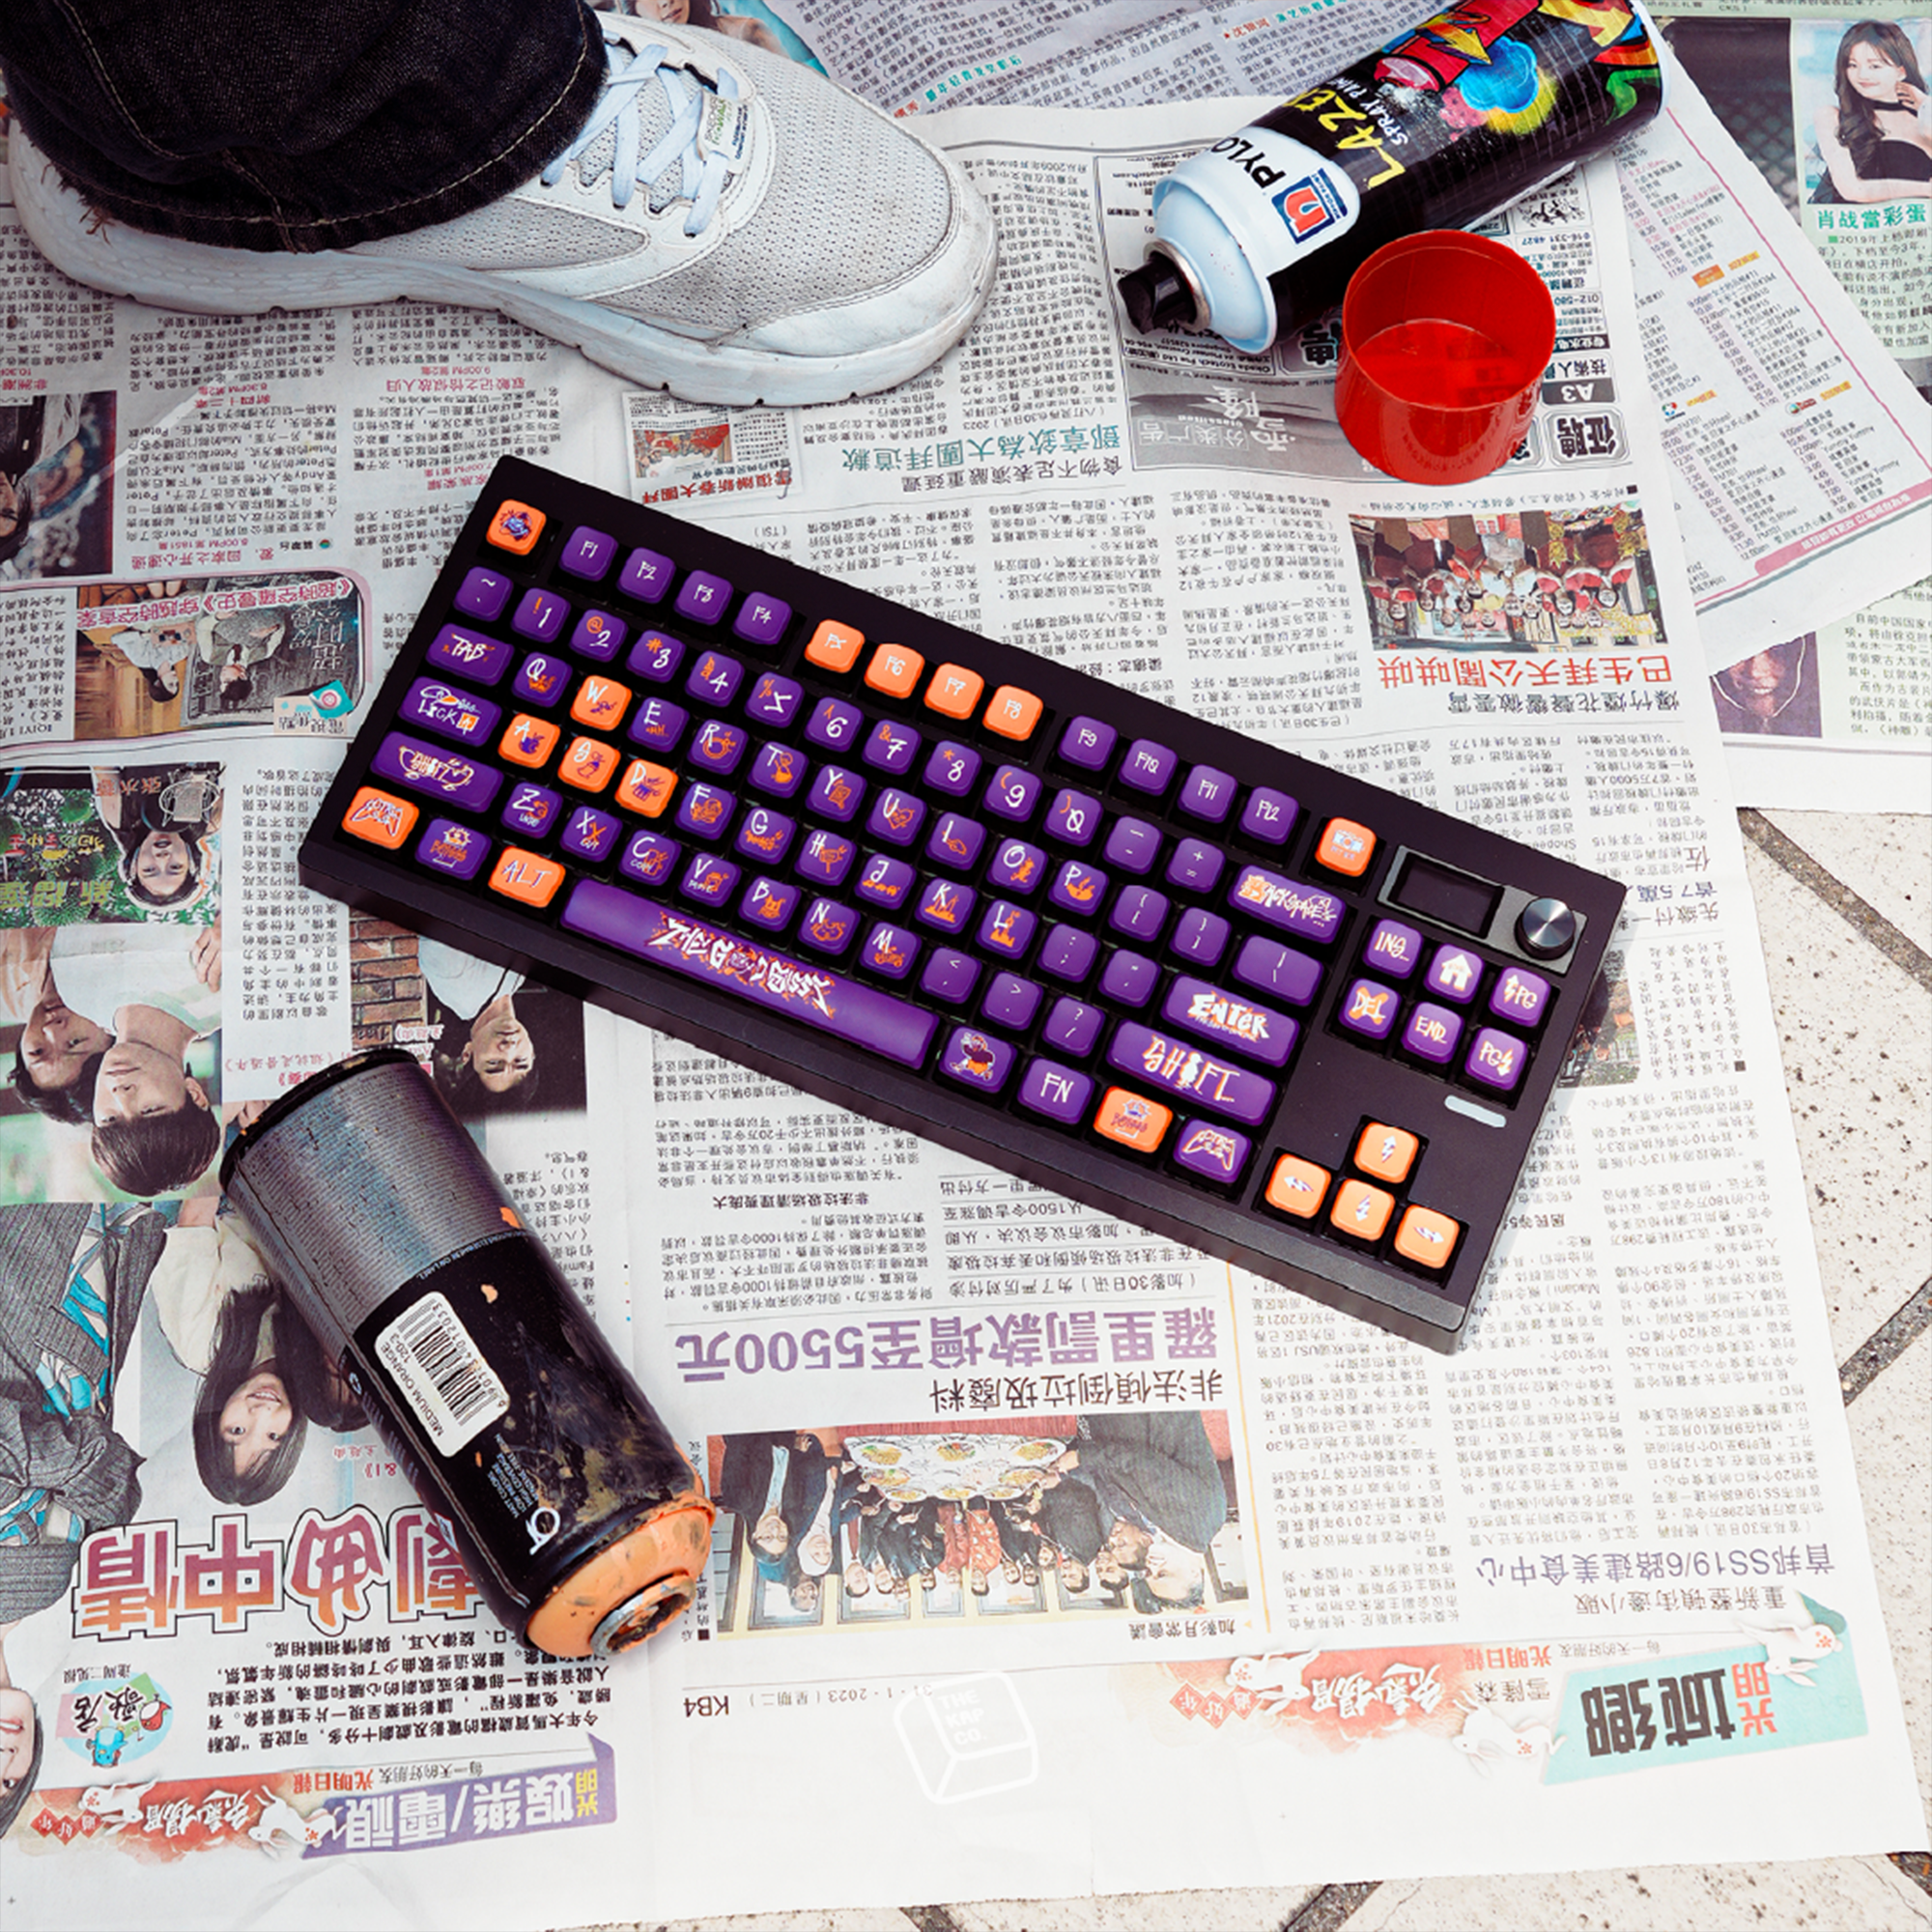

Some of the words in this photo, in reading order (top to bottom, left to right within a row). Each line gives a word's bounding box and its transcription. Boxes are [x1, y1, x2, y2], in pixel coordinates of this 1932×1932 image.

[1359, 98, 1409, 146] SPRAY
[1559, 384, 1595, 401] A3
[841, 421, 1121, 472] 鄧章欽為大團拜道歉
[1556, 414, 1617, 459] 征聘
[581, 540, 598, 558] F1
[637, 560, 657, 581] F2
[693, 583, 714, 603] F3
[752, 606, 773, 624] F4
[450, 633, 487, 663] TAB
[589, 630, 611, 648] 2
[526, 658, 547, 681] Q
[652, 648, 673, 669] 3
[884, 655, 906, 676] F6
[709, 671, 729, 694] 4
[1377, 655, 1673, 690] 巴生拜天公鬧哄哄
[586, 680, 609, 704] W
[944, 676, 966, 696] F7
[643, 700, 663, 726] E
[1003, 698, 1023, 720] F8
[513, 720, 531, 743] A
[698, 723, 721, 749] R
[826, 716, 849, 738] 6
[1077, 727, 1097, 748] F9
[766, 743, 784, 767] T
[886, 737, 909, 760] 7
[629, 762, 647, 786] D
[823, 767, 844, 796] Y
[947, 759, 966, 782] 8
[511, 787, 541, 811] Z
[690, 783, 712, 810] F
[882, 791, 900, 820] U
[1004, 783, 1026, 808] 9
[576, 810, 596, 836] X
[750, 809, 769, 836] G
[631, 836, 657, 859] C
[808, 833, 829, 858] H
[1003, 844, 1026, 868] O
[501, 859, 553, 889] ALT
[692, 858, 714, 880] V
[1063, 864, 1083, 887] P
[751, 880, 771, 902] B
[931, 882, 952, 907] K
[809, 901, 832, 924] N
[993, 903, 1009, 930] L
[871, 928, 895, 954] M
[1351, 988, 1386, 1020] DEL
[1414, 1015, 1447, 1044] END
[1039, 1071, 1075, 1104] FN
[387, 1331, 414, 1364] 120-3
[674, 1305, 1218, 1383] 羅里罰款增至5500元
[379, 1340, 418, 1391] ORANGE
[928, 1367, 1224, 1415] 非法傾倒垃圾廢料
[410, 1387, 447, 1436] MEDIUM
[495, 1452, 524, 1489] COVERAGE
[518, 1486, 535, 1507] HIGH
[1475, 1543, 1834, 1589] 首邦SS19/6路建美食中心
[1127, 1618, 1236, 1641] 加影月常會議
[1462, 1644, 1552, 1670] 光明日報
[1557, 1639, 1662, 1658] 每一天的好朋友
[1473, 1678, 1550, 1703] 雪隆森
[1731, 1660, 1777, 1737] 光明
[69, 1686, 145, 1734] 歌店
[683, 1694, 729, 1719] KB4
[291, 1767, 375, 1794] 光明日報
[377, 1760, 484, 1783] 每一天的好朋友
[574, 1768, 599, 1817] 光明
